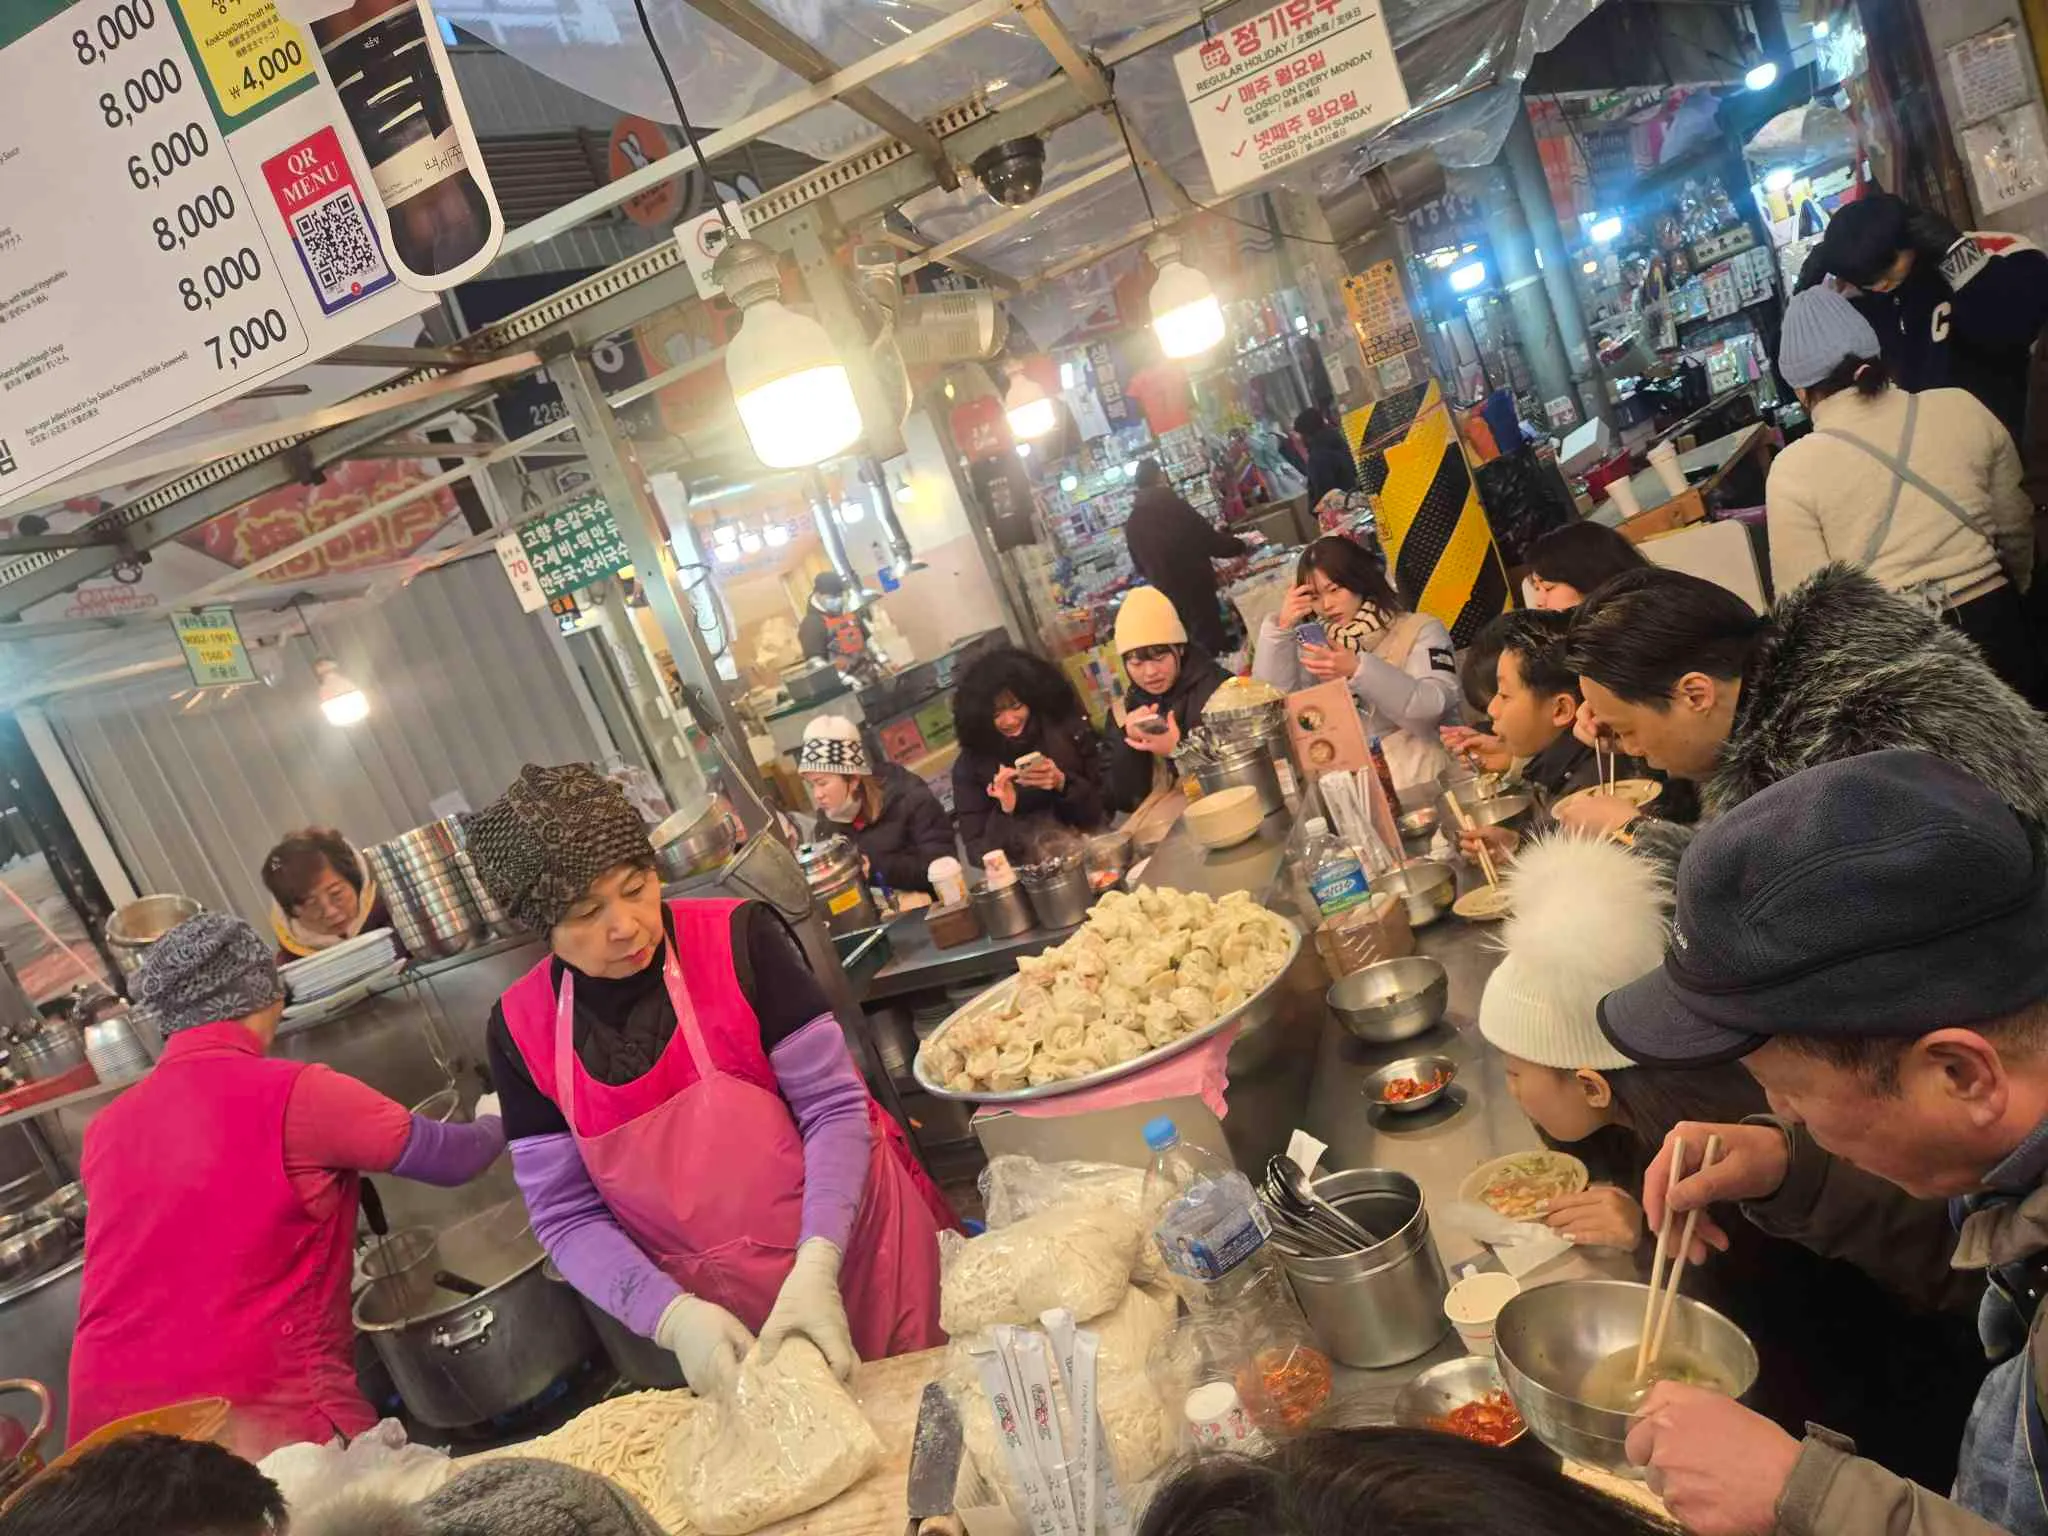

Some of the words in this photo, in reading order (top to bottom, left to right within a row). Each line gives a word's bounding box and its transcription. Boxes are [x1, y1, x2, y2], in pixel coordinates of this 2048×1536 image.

[72, 0, 156, 65] 8,000
[99, 58, 182, 128] 8,000
[1196, 61, 1244, 91] REGULAR
[1244, 42, 1288, 72] HOLIDAY
[1238, 75, 1273, 103] 매주
[1275, 50, 1326, 87] 월요일
[1243, 91, 1281, 116] CLOSED
[1281, 84, 1298, 98] ON
[1298, 70, 1329, 91] EVERY
[1329, 50, 1374, 77] MONDAY
[1253, 114, 1304, 151] 넷째주
[1307, 90, 1358, 127] 일요일
[1258, 138, 1297, 162] CLOSED
[1298, 130, 1312, 145] ON
[1312, 124, 1331, 139] 4TH
[1332, 104, 1374, 131] SUNDAY
[127, 122, 209, 190] 6,000
[282, 161, 339, 206] MENU
[287, 147, 318, 175] QR
[152, 185, 235, 251] 8,000
[177, 248, 261, 311] 8,000
[204, 309, 287, 370] 7,000
[522, 524, 552, 548] 고향
[509, 560, 528, 577] 70
